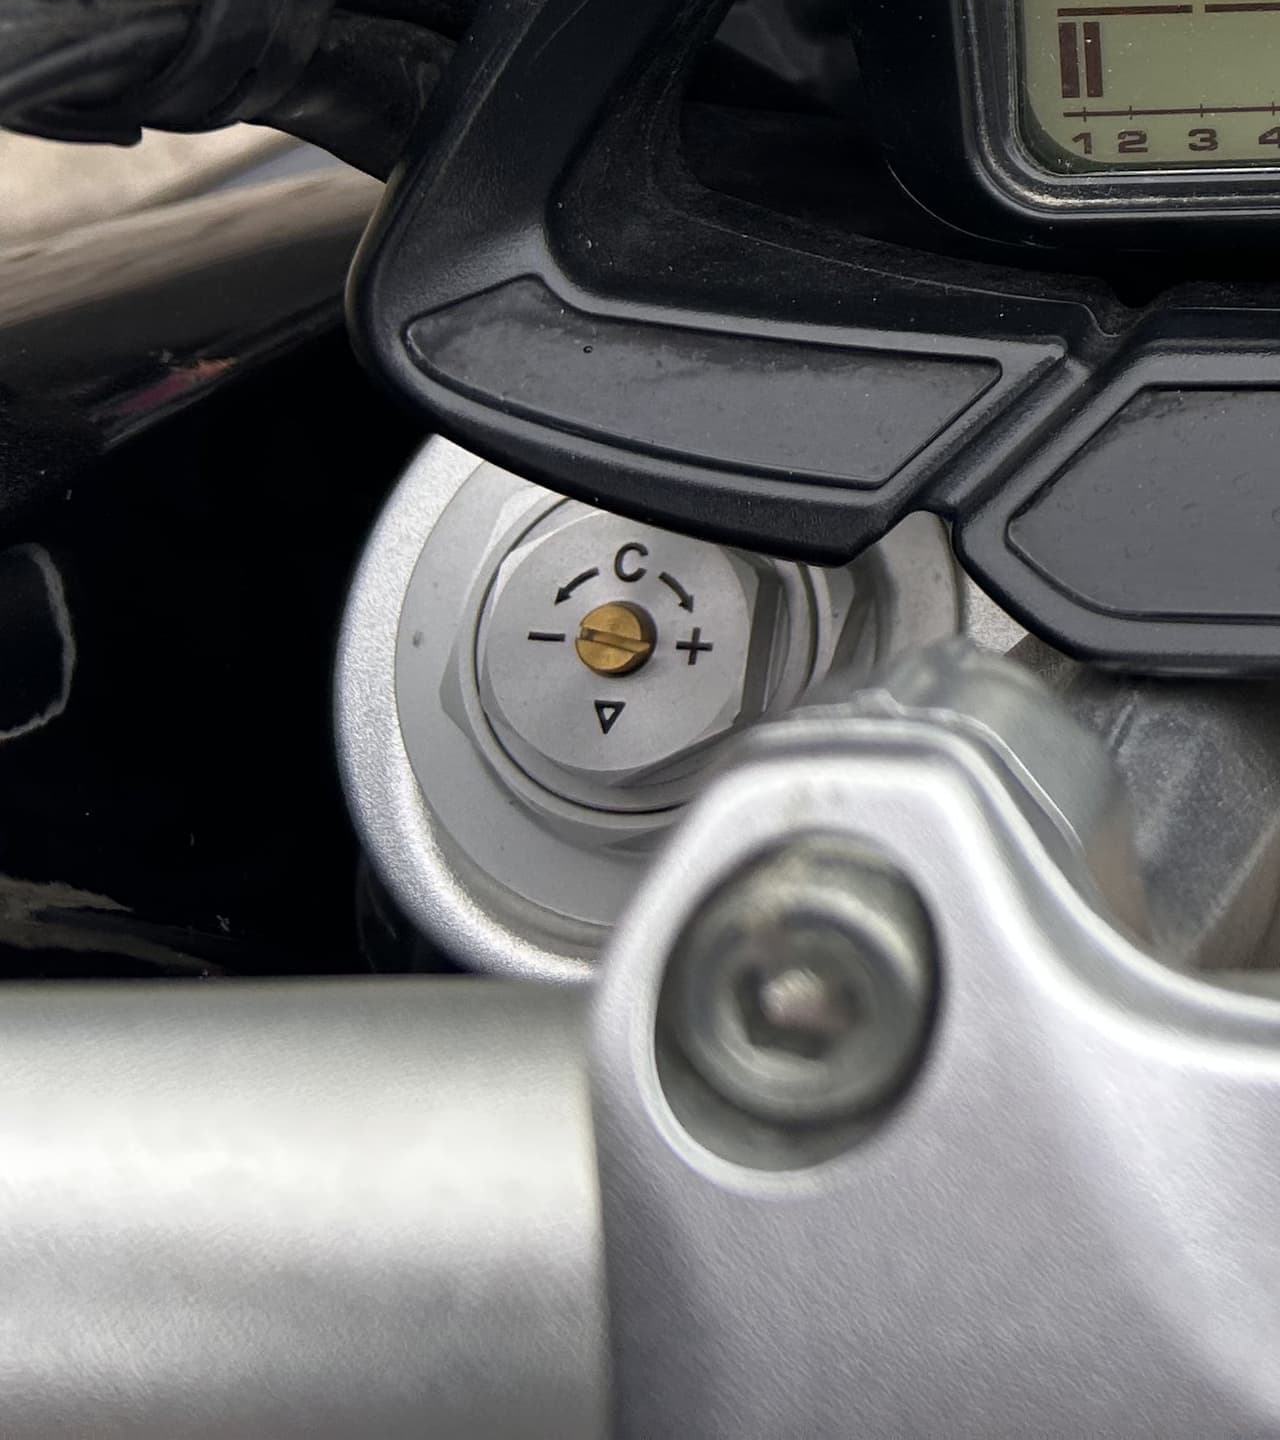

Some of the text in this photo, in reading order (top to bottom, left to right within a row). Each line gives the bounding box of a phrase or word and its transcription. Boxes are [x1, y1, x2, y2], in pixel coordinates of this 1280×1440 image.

[1072, 132, 1094, 154] 1
[1117, 130, 1149, 153] 2
[1187, 128, 1219, 152] 3
[613, 542, 649, 583] C
